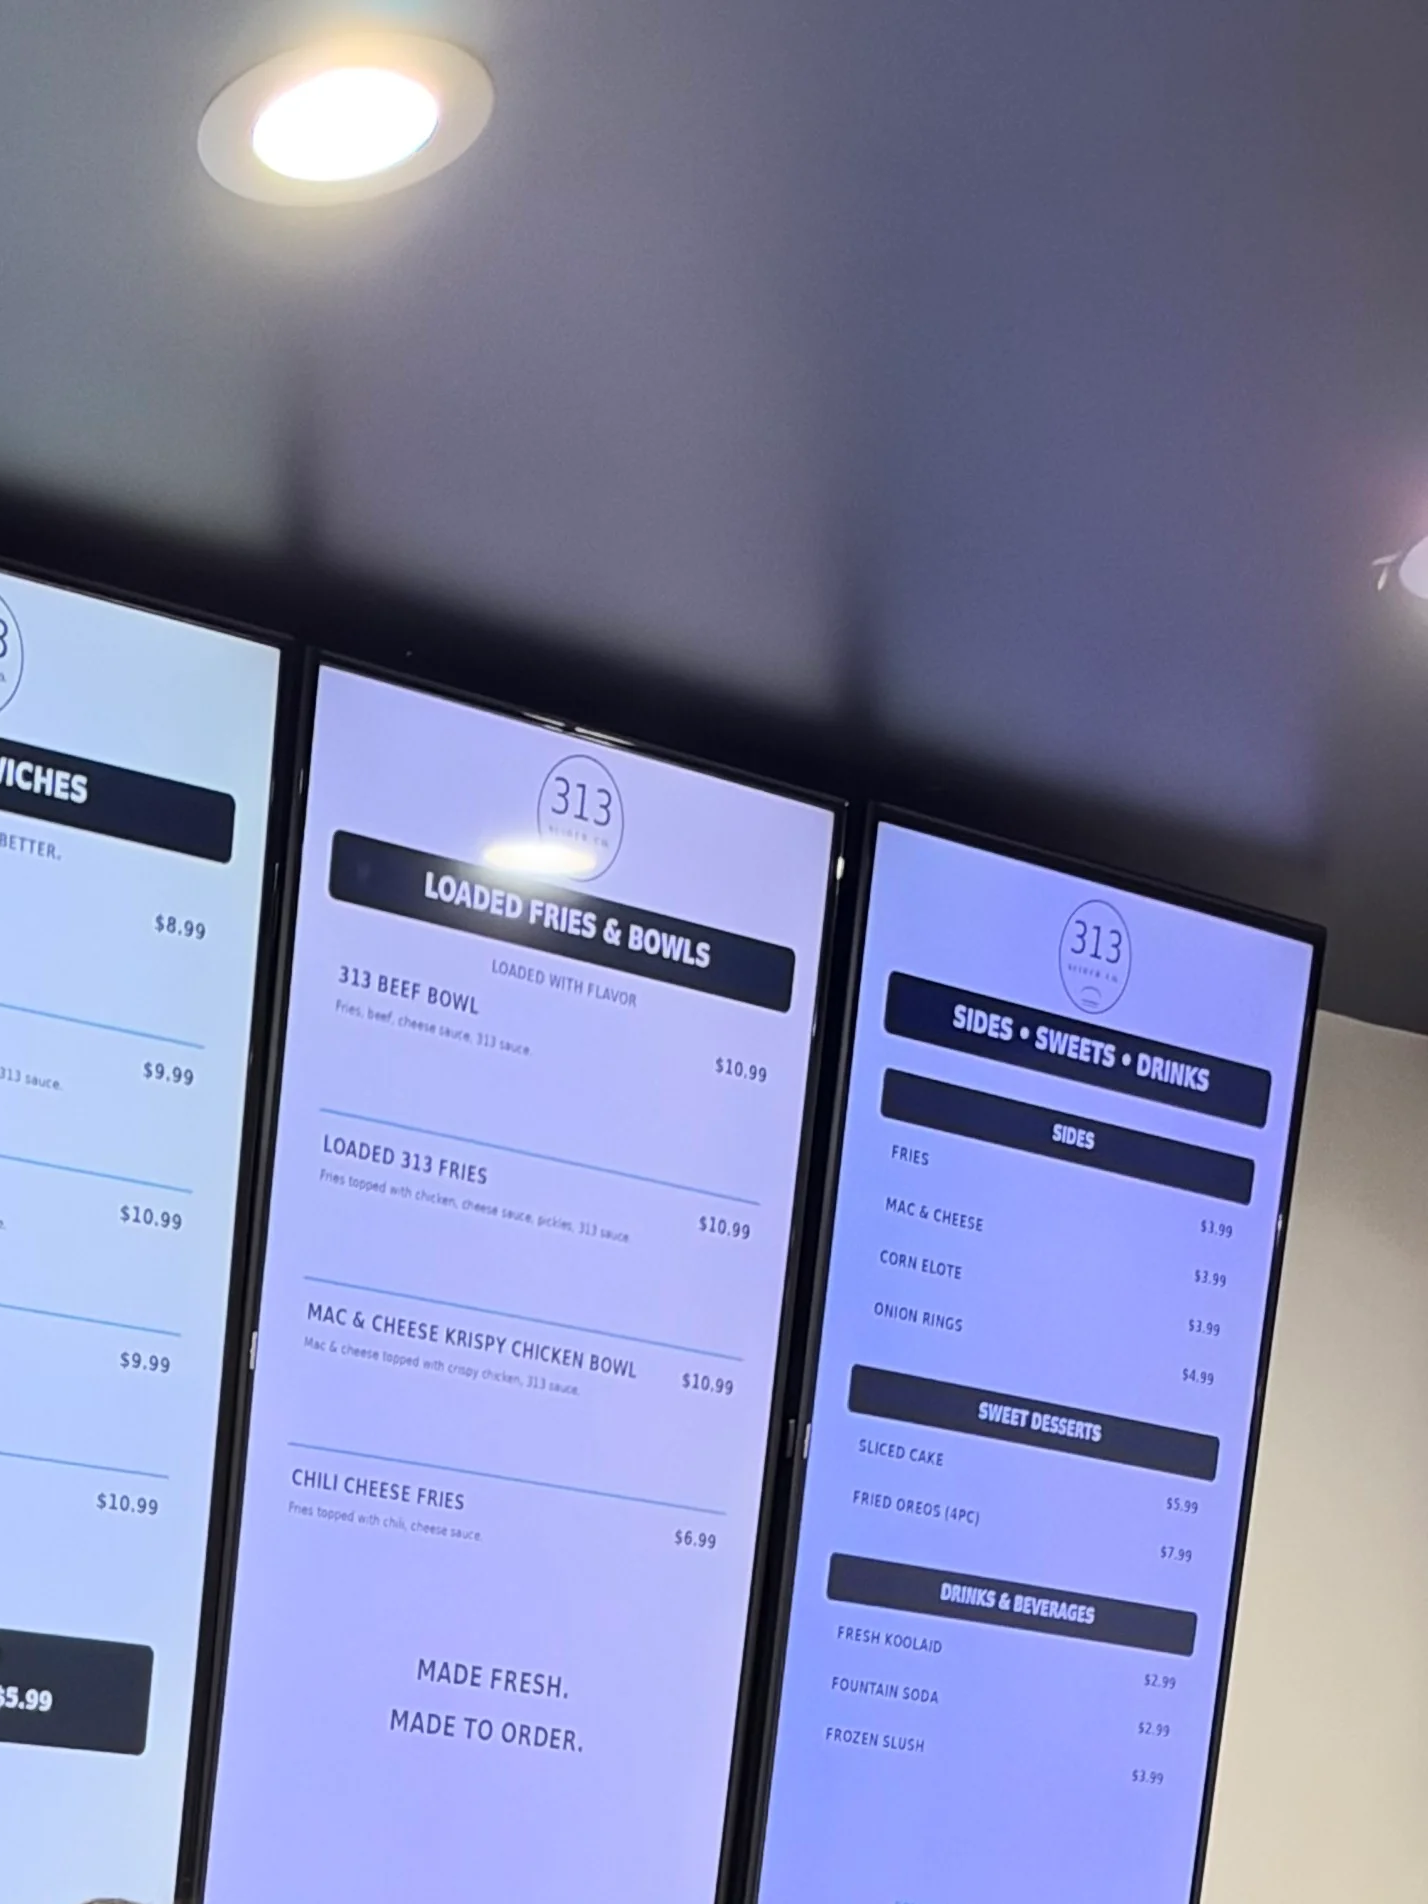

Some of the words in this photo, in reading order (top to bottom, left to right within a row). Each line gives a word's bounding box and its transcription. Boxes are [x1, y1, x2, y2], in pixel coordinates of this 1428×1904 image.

[155, 914, 205, 939] $8.99
[424, 871, 522, 918] LOADED
[529, 902, 596, 938] FRIES
[602, 918, 621, 946] &
[627, 924, 710, 968] BOWLS
[339, 966, 371, 989] 313
[377, 975, 420, 1000] BEEF
[427, 986, 478, 1014] BOWL
[952, 1004, 1013, 1041] SIDES
[1034, 1025, 1115, 1067] SWEETS
[1136, 1052, 1209, 1092] DRINKS
[144, 1061, 194, 1085] $9.99
[715, 1057, 767, 1083] $10.99
[885, 1197, 915, 1216] MAC
[919, 1205, 928, 1219] &
[933, 1208, 983, 1232] CHEESE
[97, 1492, 158, 1515] $10.99
[291, 1468, 338, 1491] CHILI
[343, 1476, 410, 1502] CHEESE
[416, 1487, 463, 1510] FRIES
[853, 1490, 892, 1509] FRIED
[896, 1497, 940, 1517] OREOS
[944, 1505, 979, 1526] (4PC)
[674, 1529, 716, 1549] $6.99
[417, 1658, 482, 1687] MADE
[490, 1668, 567, 1698] FRESH.
[390, 1709, 455, 1737] MADE
[463, 1717, 493, 1741] TO
[501, 1721, 582, 1752] ORDER.
